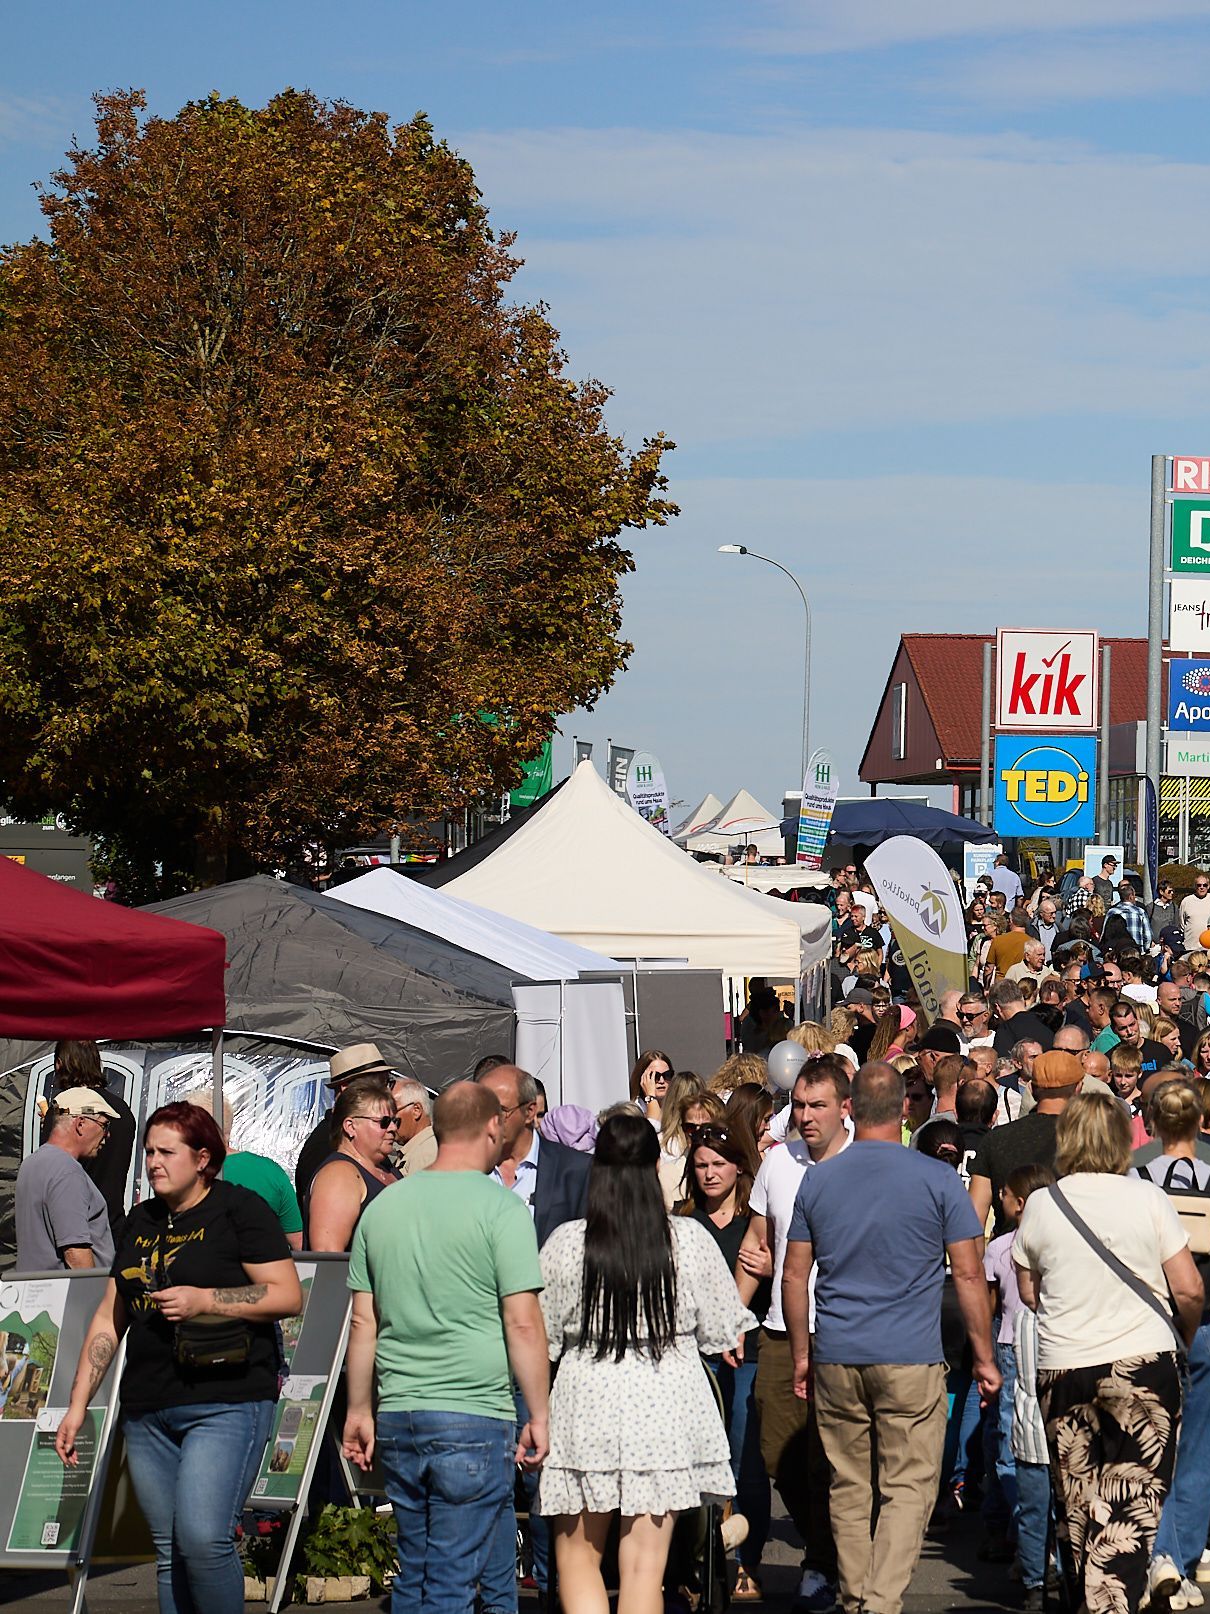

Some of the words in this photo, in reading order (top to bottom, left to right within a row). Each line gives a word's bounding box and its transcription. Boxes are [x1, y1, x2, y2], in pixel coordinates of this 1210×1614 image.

[1174, 603, 1201, 612] JEANS
[614, 757, 628, 795] EIN
[1001, 770, 1089, 803] TEDi
